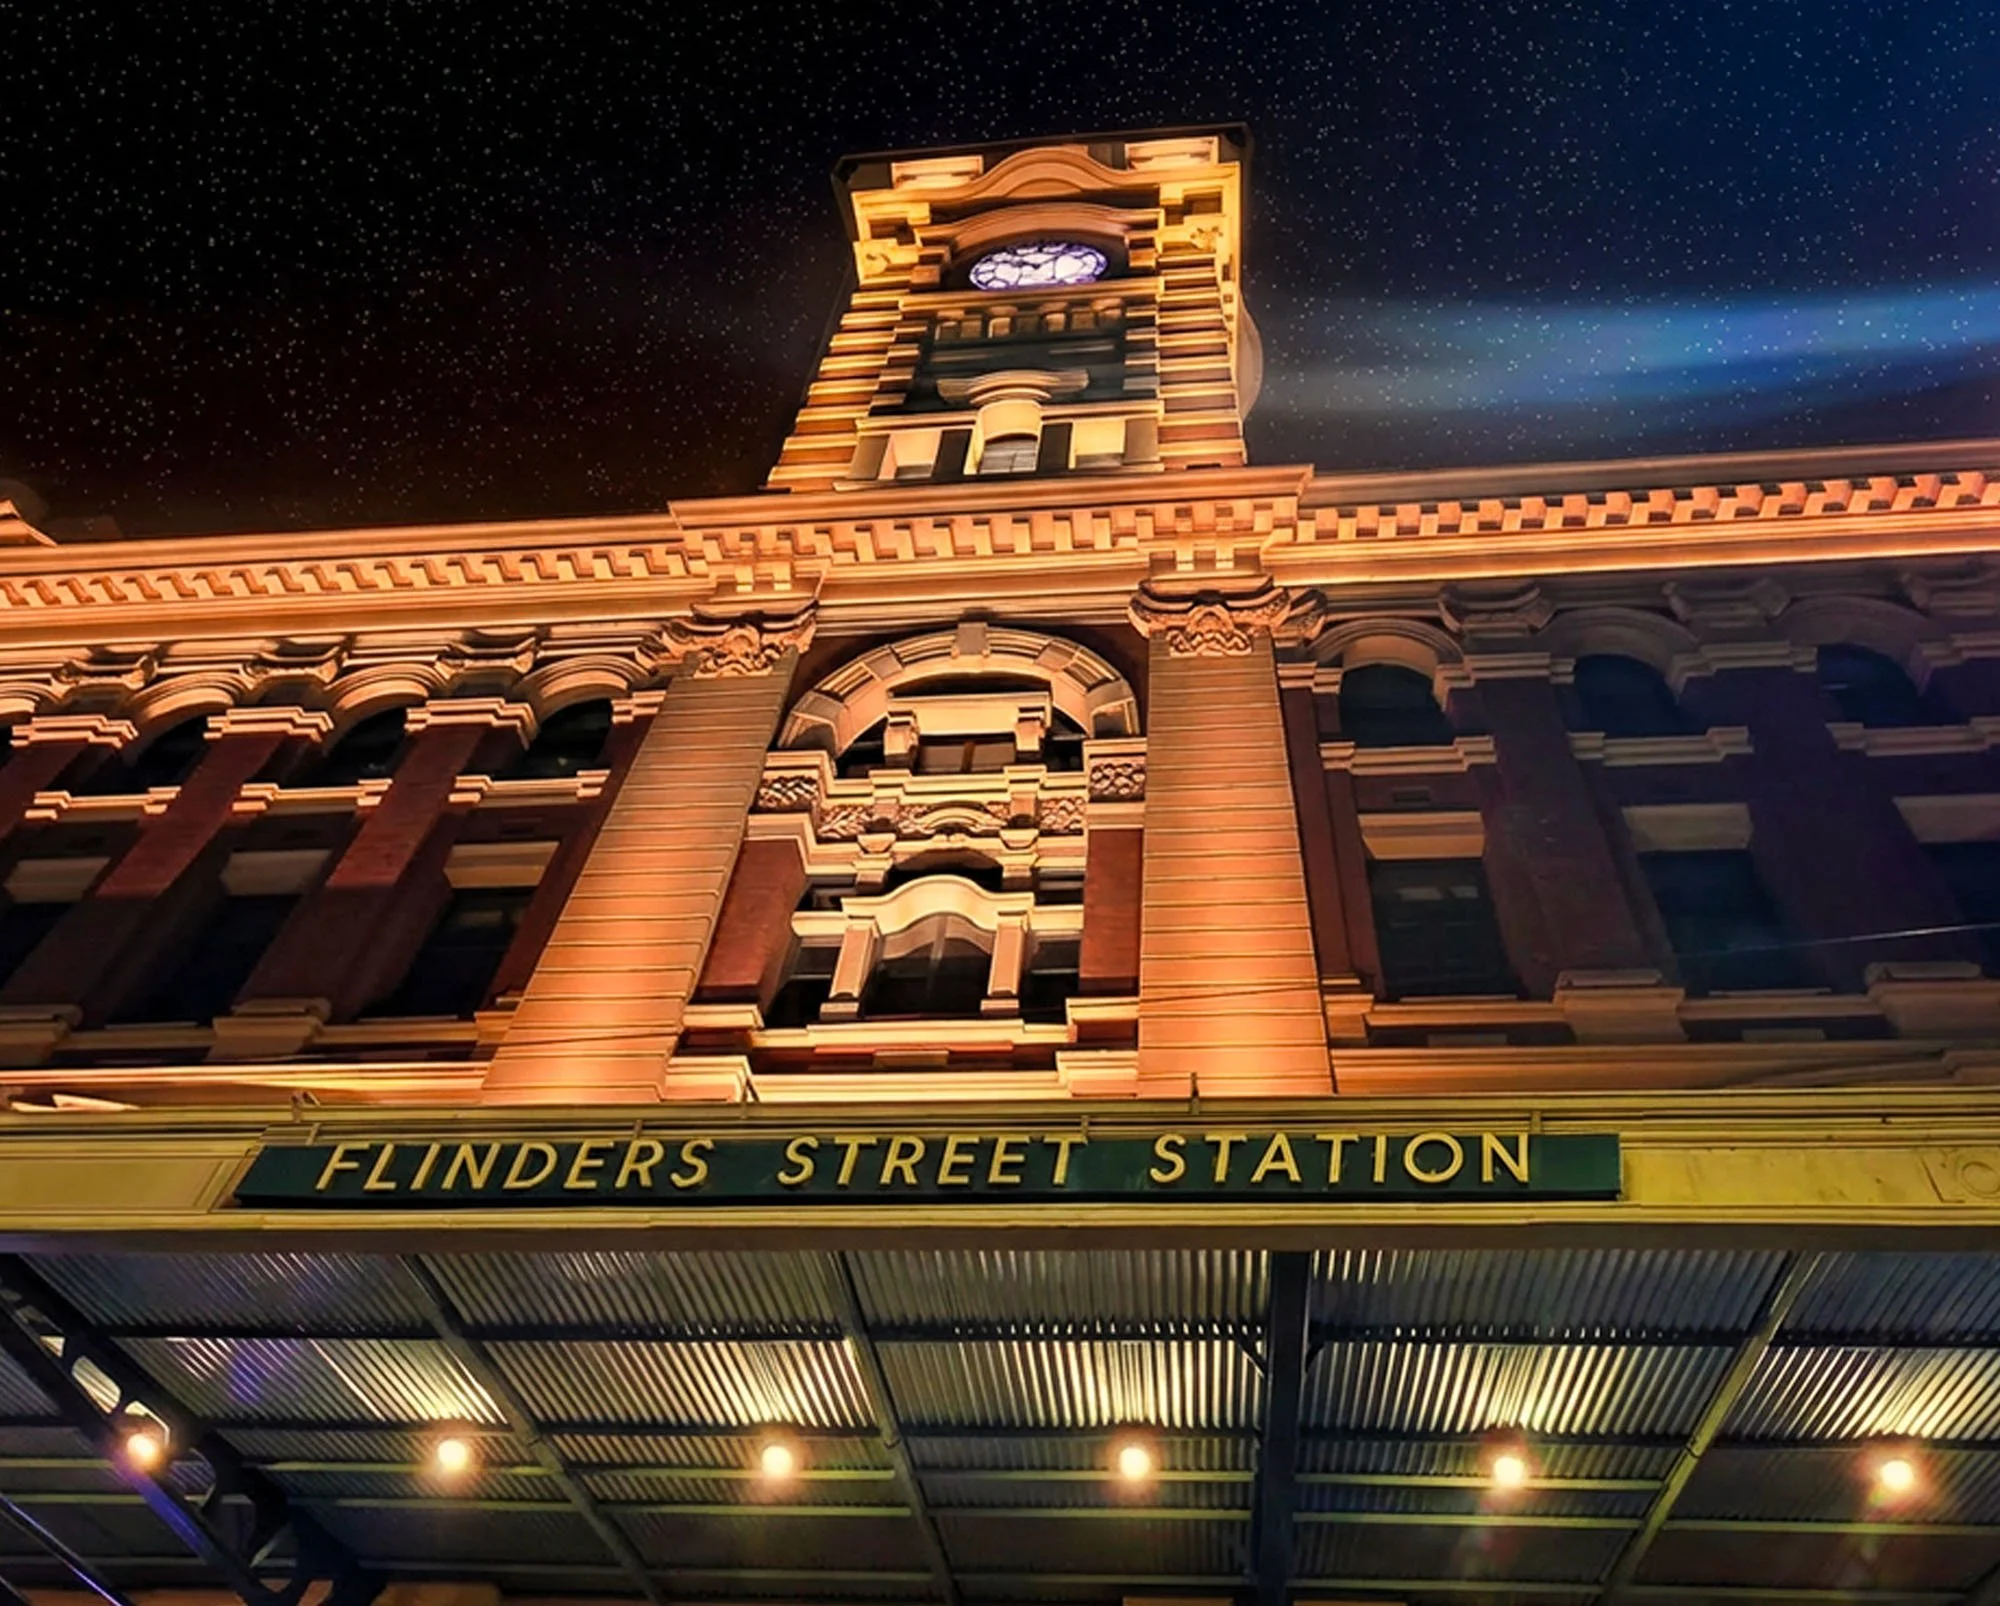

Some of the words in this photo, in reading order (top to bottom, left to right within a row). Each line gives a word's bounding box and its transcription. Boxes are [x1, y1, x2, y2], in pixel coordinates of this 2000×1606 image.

[315, 1137, 715, 1190] FLINDERS
[777, 1134, 1088, 1185] STREET
[1149, 1132, 1529, 1184] STATION
